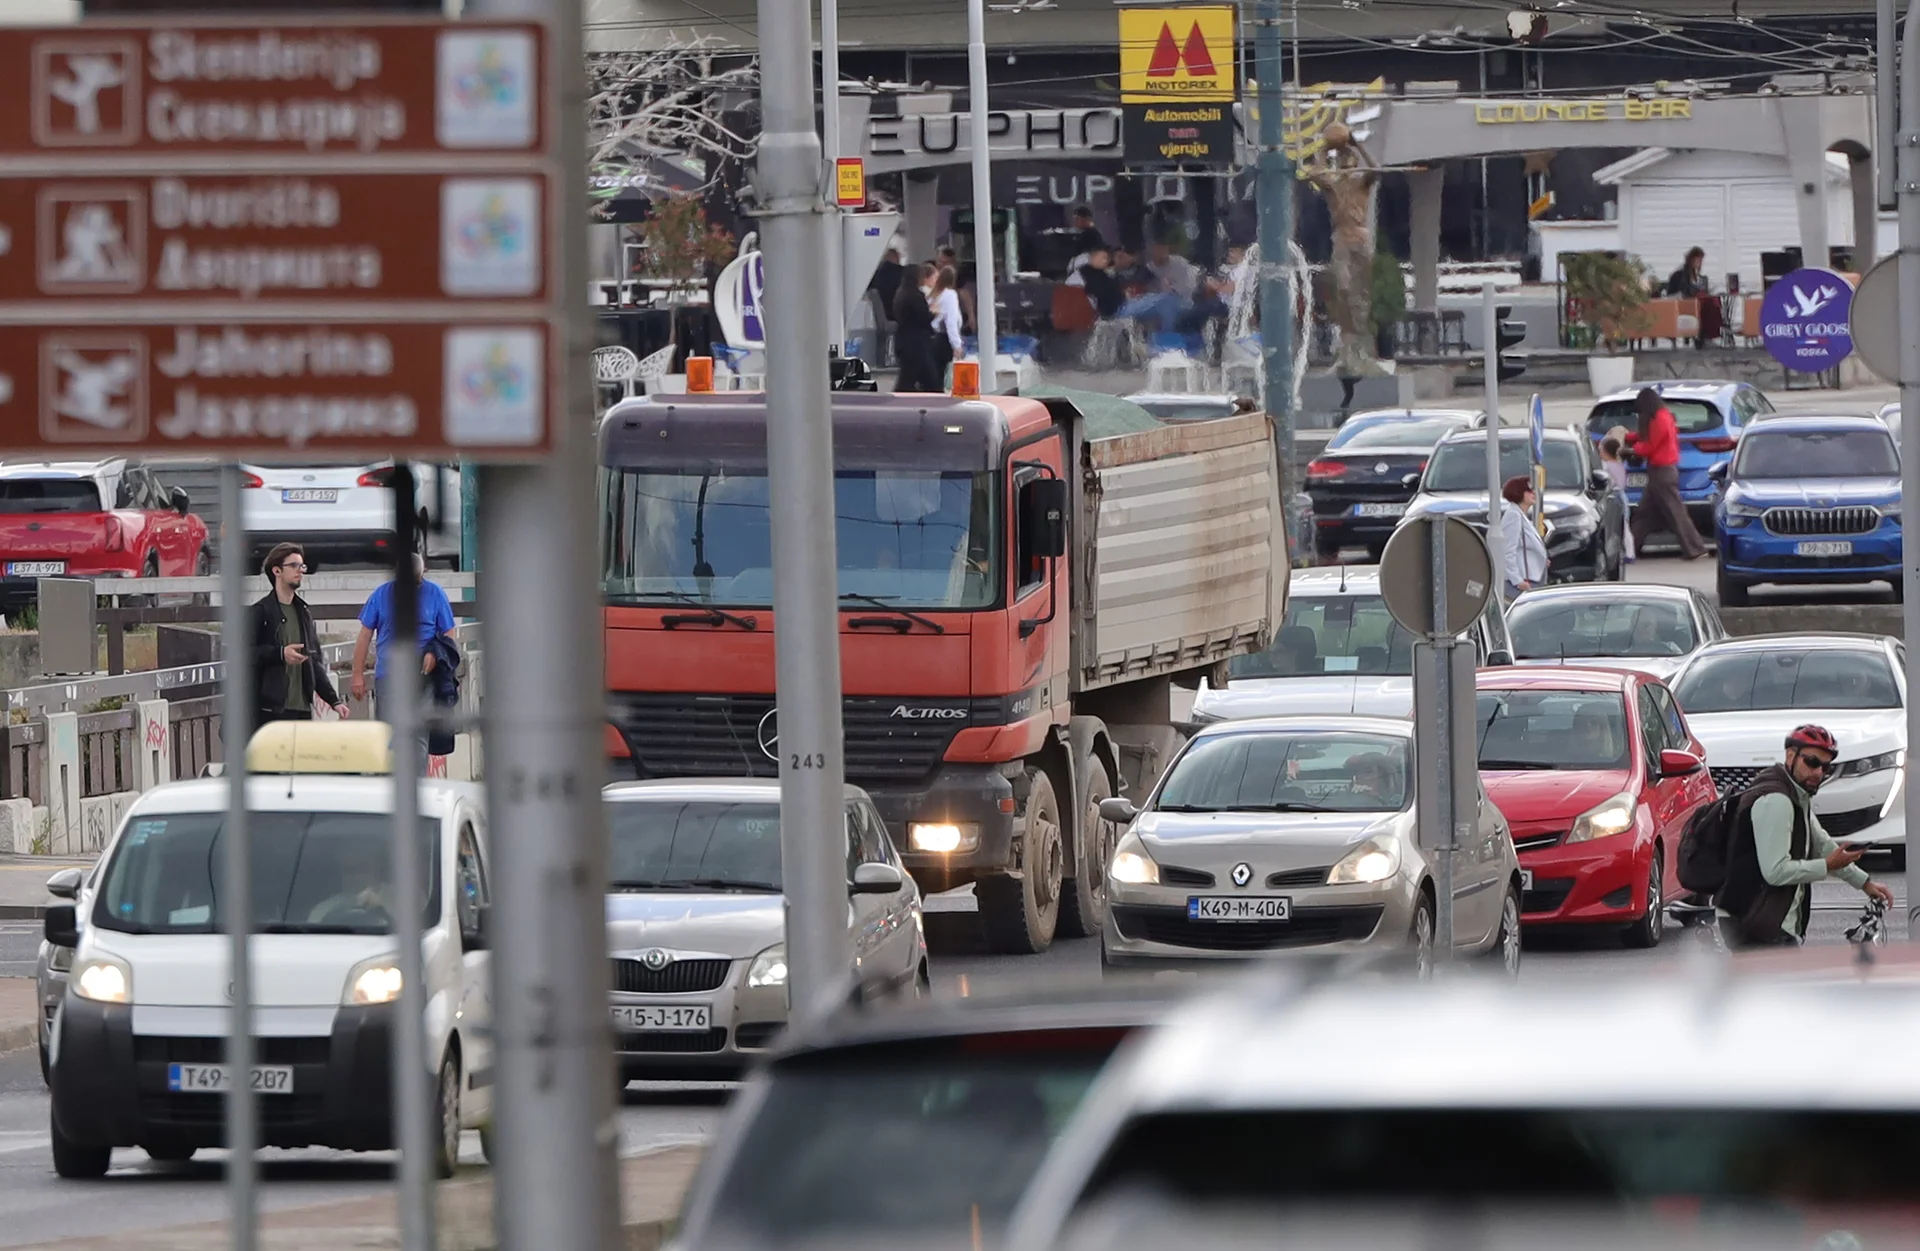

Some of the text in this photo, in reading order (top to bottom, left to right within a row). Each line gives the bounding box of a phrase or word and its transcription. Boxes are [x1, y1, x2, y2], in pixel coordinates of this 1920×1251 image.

[149, 31, 382, 91] Skenderija
[1145, 81, 1217, 89] MOTOREX
[1144, 108, 1222, 122] Automobili
[1476, 100, 1691, 123] LOUNGE BAR
[1159, 142, 1209, 158] vjeruju
[1765, 323, 1849, 337] GREY GOOS
[156, 324, 394, 377] Jahorina
[14, 563, 62, 573] E37-A-971
[890, 705, 968, 718] ACTROS
[791, 753, 825, 770] 243
[1201, 901, 1286, 916] K49-M-406
